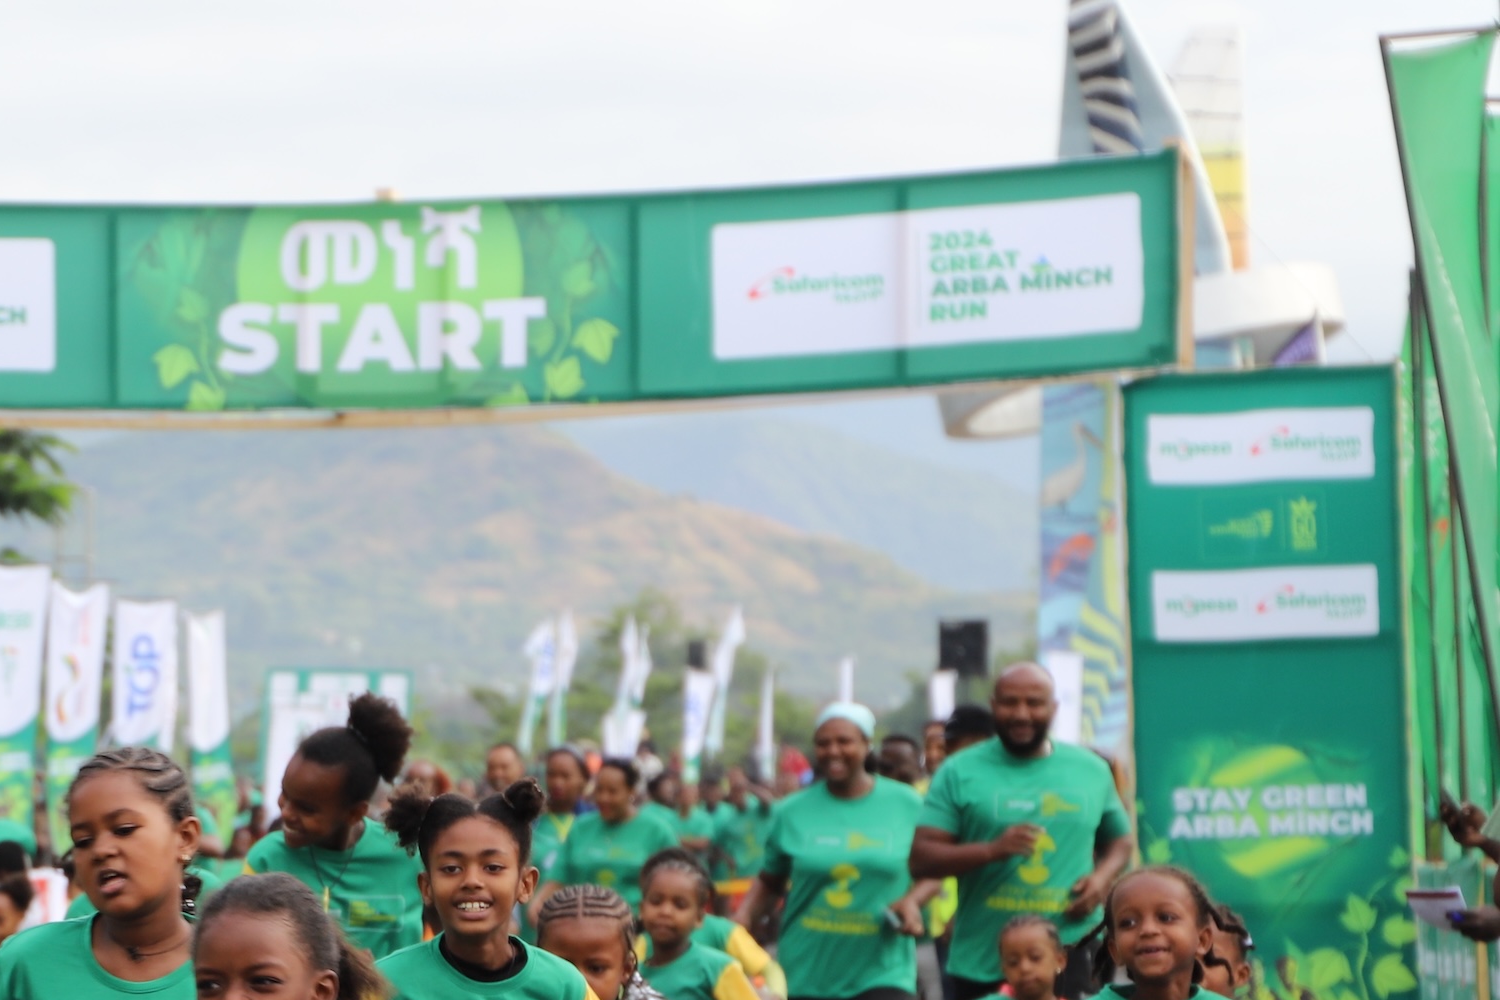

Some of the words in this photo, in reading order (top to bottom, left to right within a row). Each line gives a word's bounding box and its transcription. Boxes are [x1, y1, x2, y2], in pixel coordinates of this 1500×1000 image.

[930, 232, 992, 251] 2024
[928, 251, 1020, 273] GREAT
[932, 275, 1009, 298] ARBA
[929, 300, 988, 322] RUN
[217, 296, 547, 374] START
[126, 634, 160, 718] TOP
[1172, 787, 1251, 812] STAY
[1260, 783, 1367, 809] GREEN
[1171, 814, 1260, 839] ARBA
